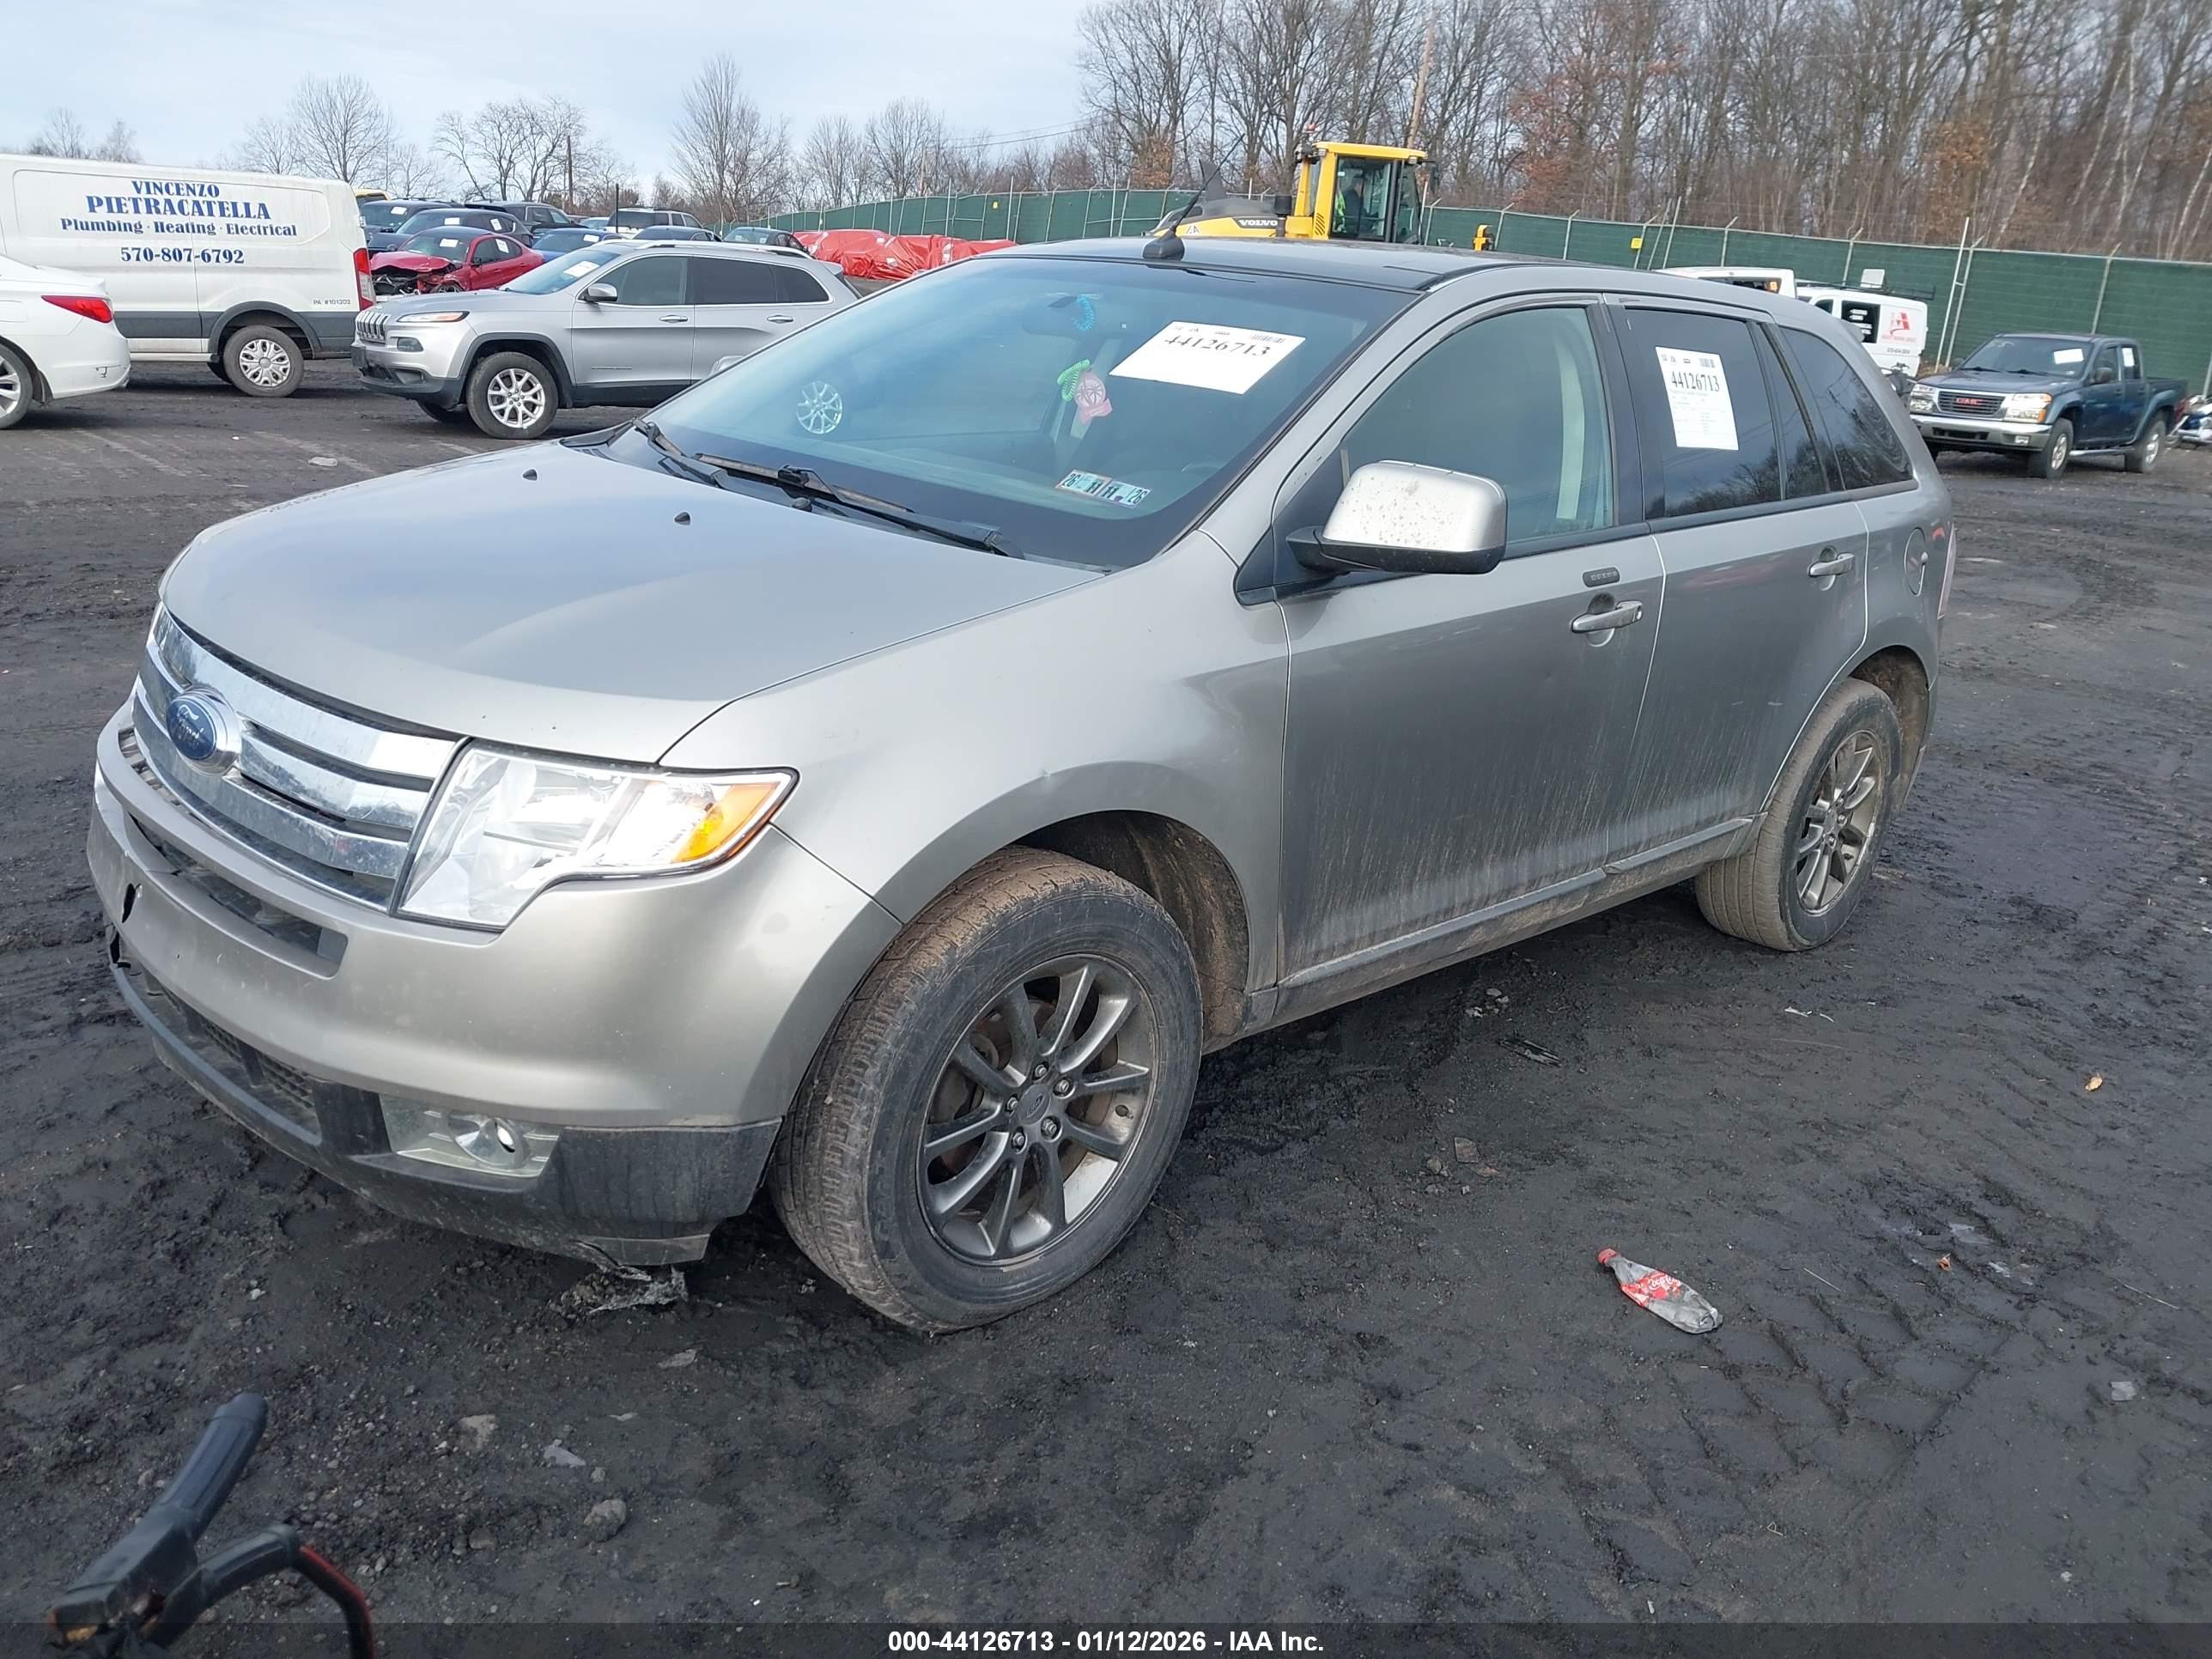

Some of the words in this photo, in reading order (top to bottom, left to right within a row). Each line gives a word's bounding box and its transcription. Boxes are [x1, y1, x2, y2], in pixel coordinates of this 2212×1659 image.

[131, 179, 221, 198] VINCENZO
[85, 195, 271, 220] PIETRACATELLA
[60, 217, 143, 234] Plumbing
[154, 220, 216, 236] Heating
[226, 222, 297, 236] Electrical
[119, 246, 246, 264] 570-807-6792
[1164, 334, 1272, 356] 44126713
[1671, 370, 1720, 392] 44126713
